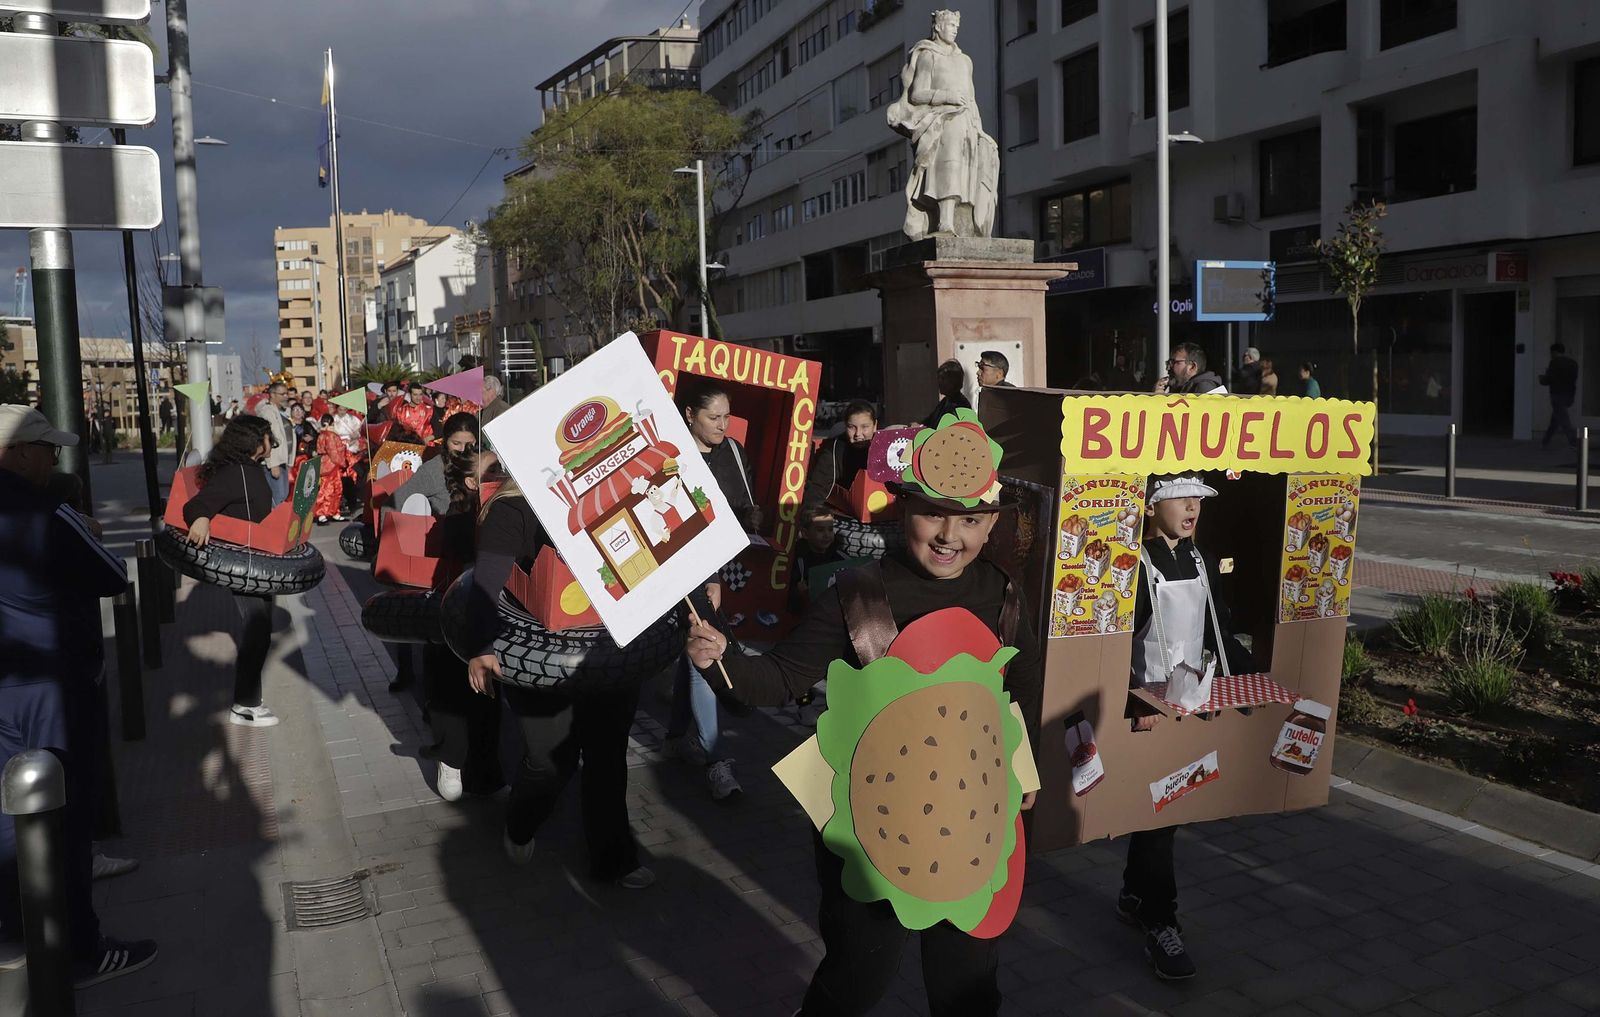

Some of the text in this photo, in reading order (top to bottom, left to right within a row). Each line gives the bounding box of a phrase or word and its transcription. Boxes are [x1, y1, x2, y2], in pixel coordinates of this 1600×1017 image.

[671, 336, 809, 395] TAQUILLA
[570, 407, 597, 438] Uranga
[1080, 398, 1362, 461] BUÑUELOS
[584, 444, 636, 486] BURGERS
[770, 397, 814, 590] CHOQUE
[1285, 728, 1320, 746] nutella
[1165, 772, 1190, 795] bueno
